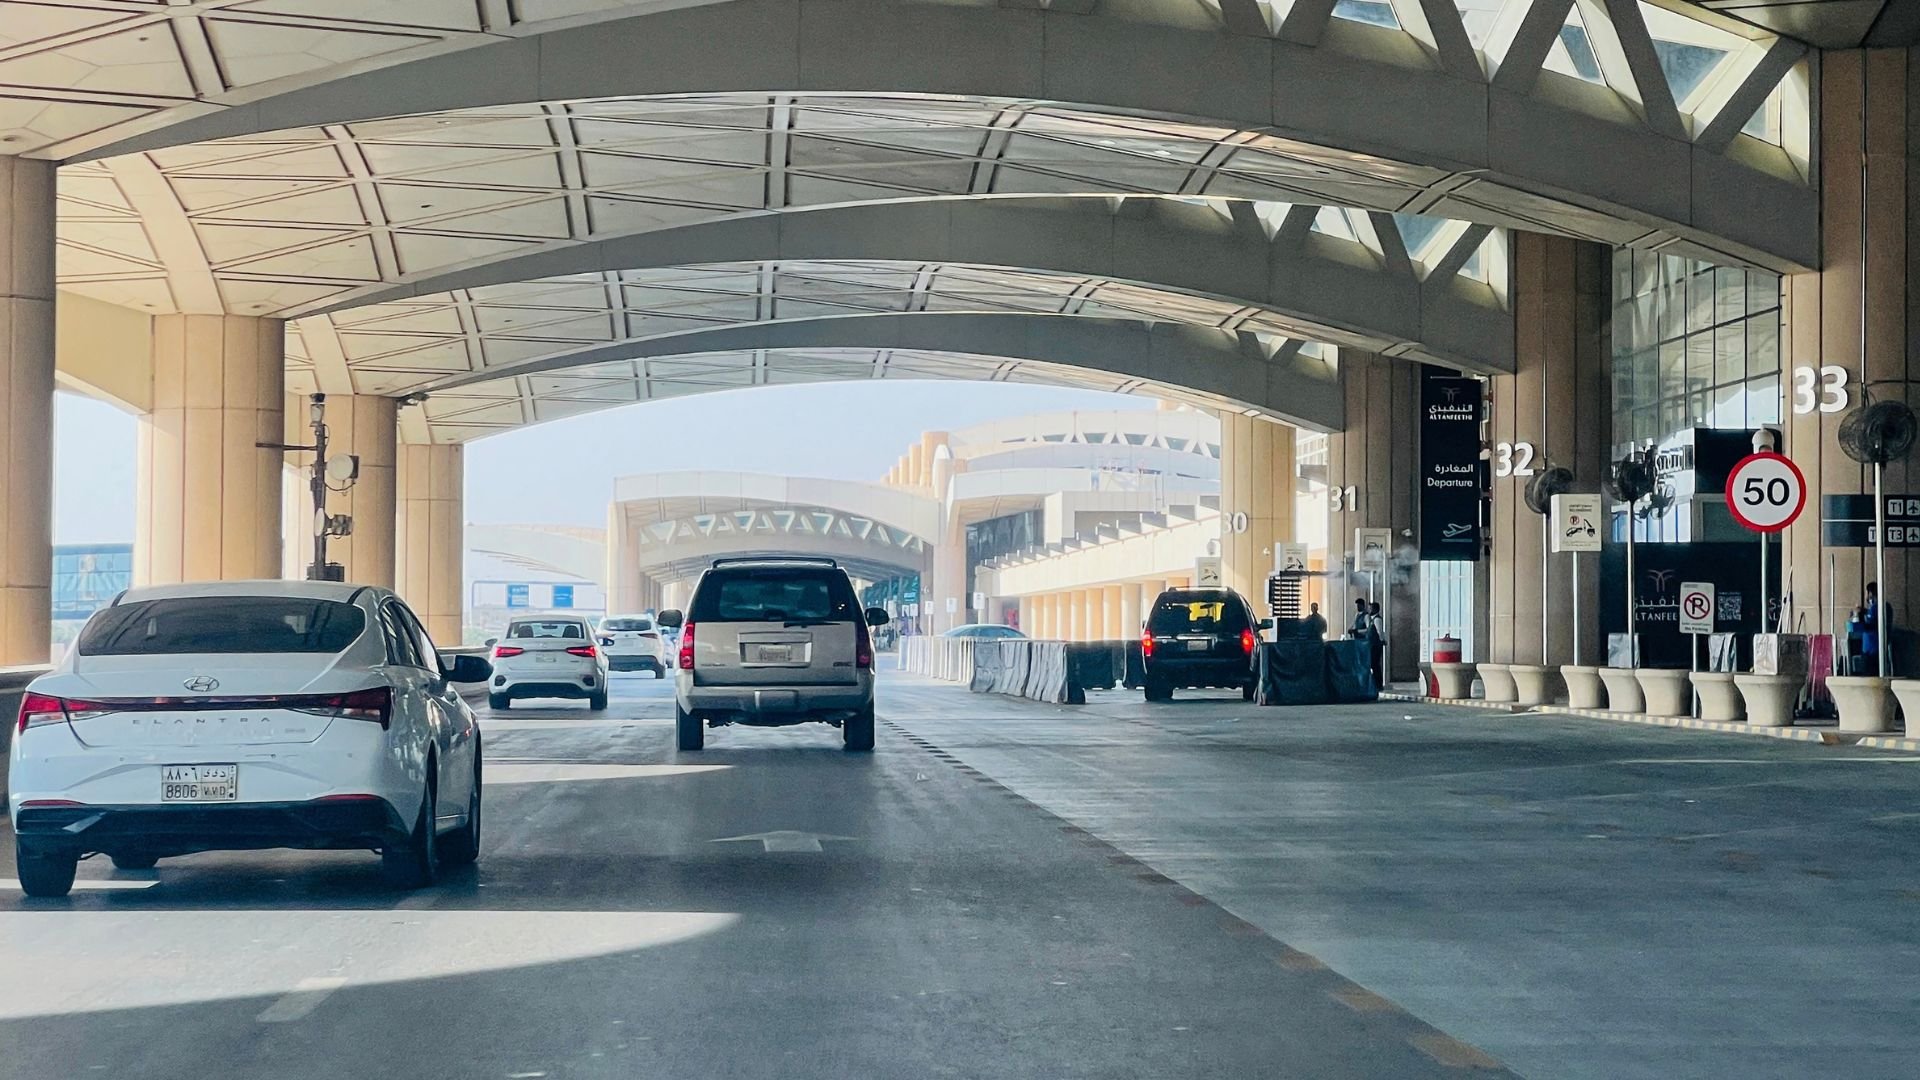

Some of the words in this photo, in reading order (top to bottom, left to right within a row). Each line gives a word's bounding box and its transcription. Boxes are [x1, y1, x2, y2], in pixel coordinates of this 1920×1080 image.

[1793, 365, 1848, 414] 33
[1496, 442, 1534, 477] 32
[1435, 463, 1474, 475] المغادرة
[1427, 477, 1473, 489] Departure
[1330, 485, 1357, 512] 31
[1743, 477, 1790, 506] 50
[1890, 501, 1902, 513] T1
[1223, 511, 1248, 534] 30
[1889, 529, 1902, 541] T3
[132, 717, 270, 725] ELANTRA
[166, 784, 198, 798] 8806
